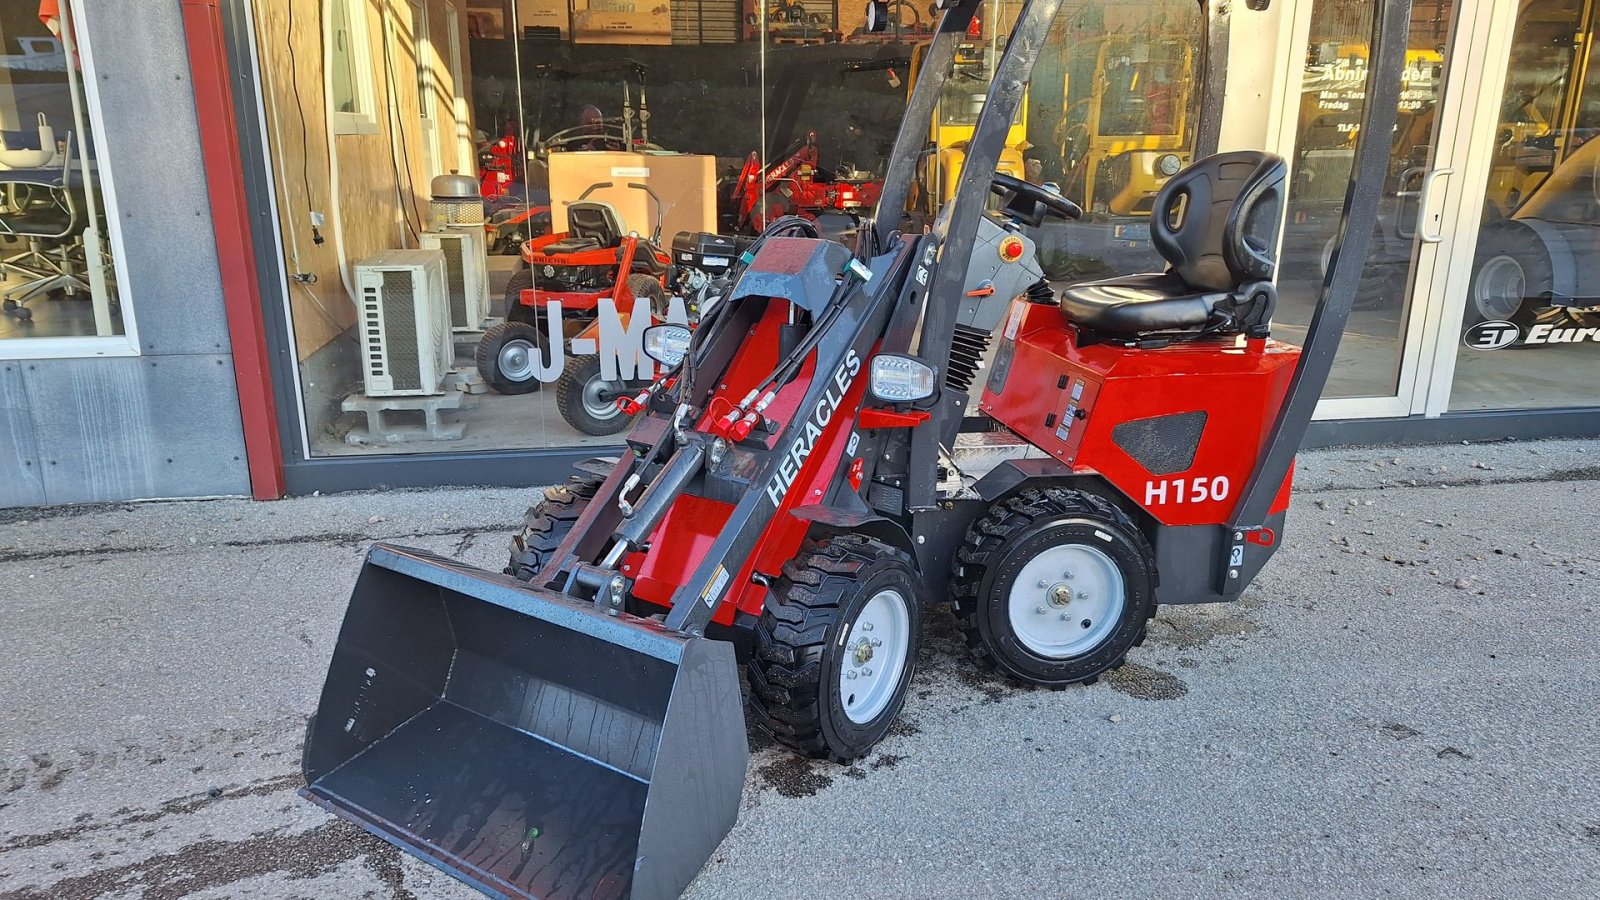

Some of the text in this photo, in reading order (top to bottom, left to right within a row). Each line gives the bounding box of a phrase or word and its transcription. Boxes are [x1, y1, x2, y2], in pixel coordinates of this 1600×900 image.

[1320, 91, 1338, 99] Man
[1319, 101, 1348, 111] Fredag
[767, 350, 861, 508] HERACLES
[1145, 476, 1229, 506] H150
